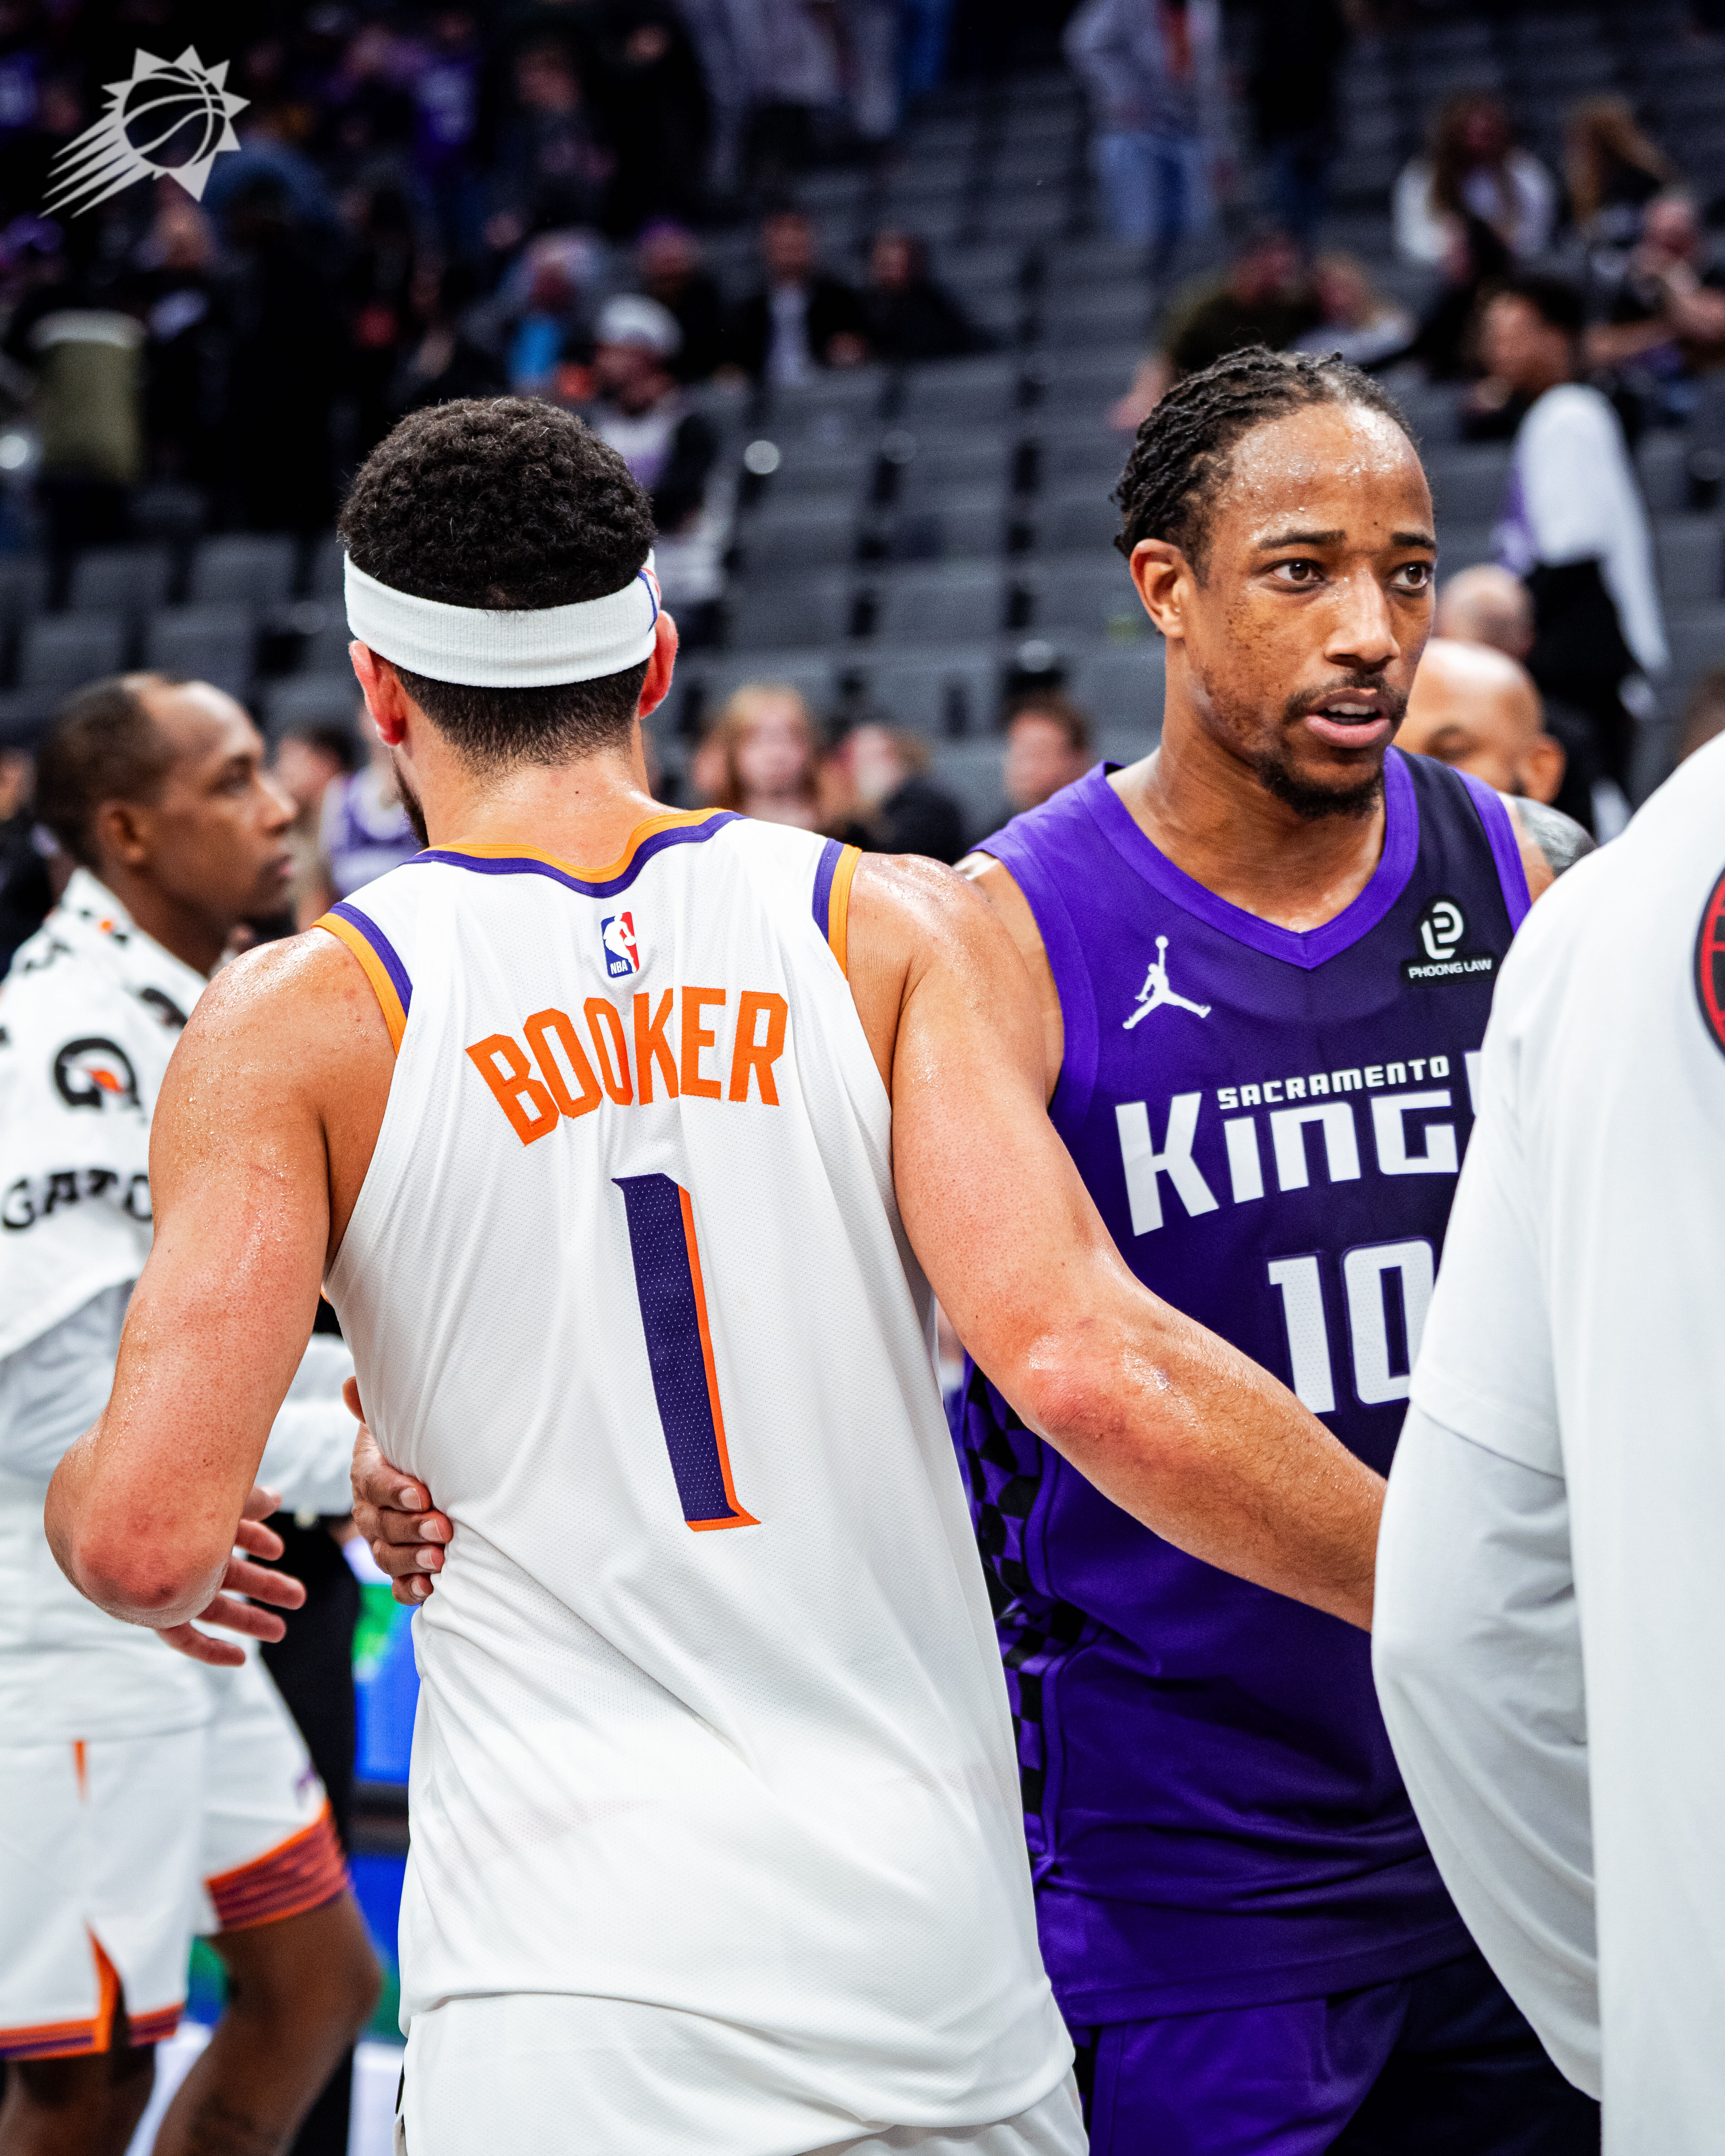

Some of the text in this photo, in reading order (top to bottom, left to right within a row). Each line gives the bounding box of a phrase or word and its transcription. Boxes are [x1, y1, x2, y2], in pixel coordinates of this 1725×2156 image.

[610, 960, 628, 975] NBA
[1408, 958, 1492, 979] PHOONG LAW
[465, 986, 789, 1147] BOOKER
[1218, 1055, 1449, 1110] SACRAMENTO
[611, 1172, 761, 1532] 1
[1268, 1240, 1434, 1414] 10
